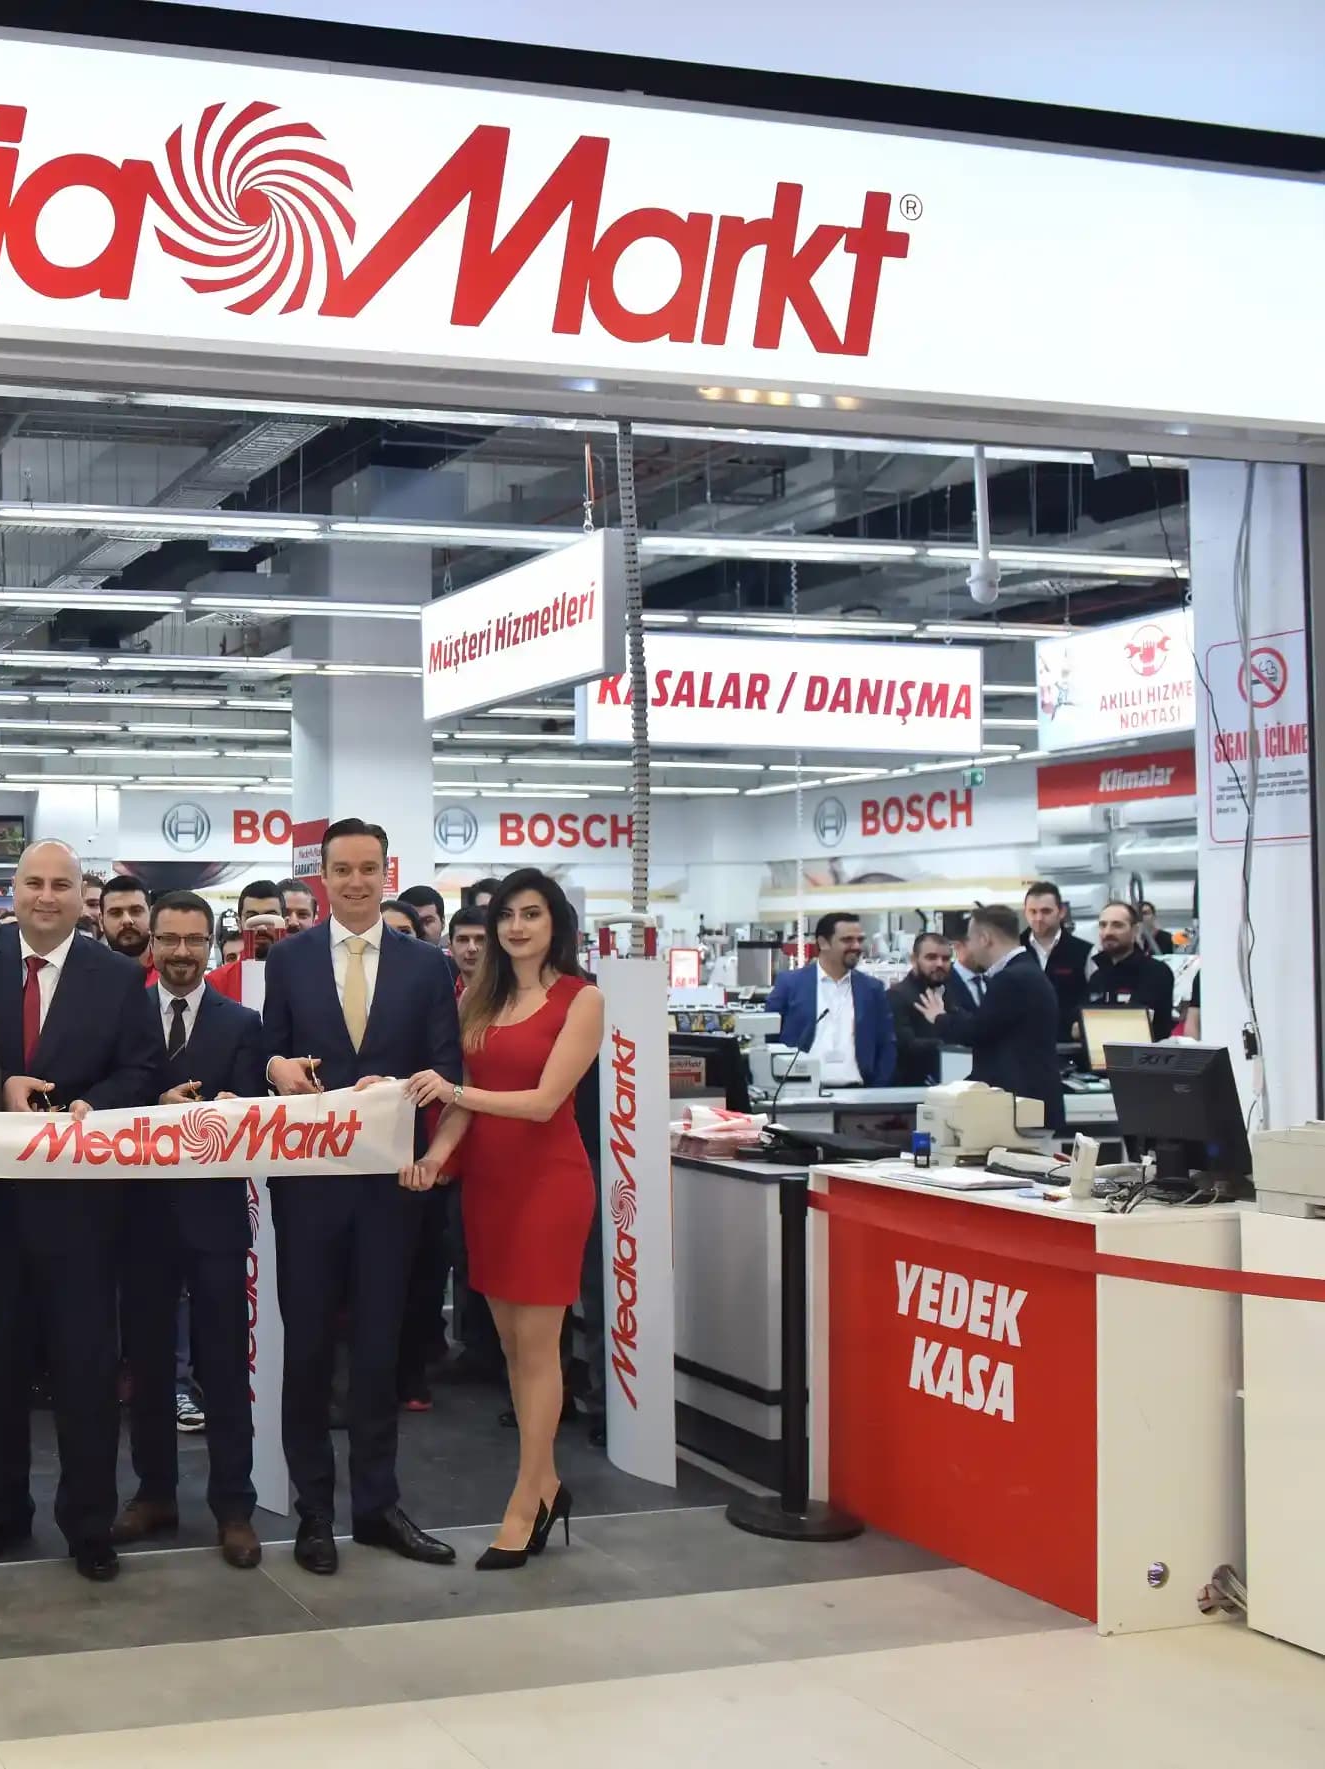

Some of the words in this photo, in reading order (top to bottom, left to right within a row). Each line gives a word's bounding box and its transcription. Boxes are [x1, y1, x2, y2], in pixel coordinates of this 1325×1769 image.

[429, 620, 491, 673] Müşteri
[495, 581, 595, 652] Hizmetleri
[804, 675, 972, 725] DANIŞMA
[1100, 688, 1142, 712] AKILLI
[1120, 706, 1181, 729] NOKTASI
[1099, 764, 1176, 793] Klimalar
[233, 809, 292, 845] BO
[499, 813, 634, 848] BOSCH
[861, 791, 973, 836] BOSCH
[895, 1260, 1028, 1347] YEDEK
[909, 1336, 1015, 1423] KASA
